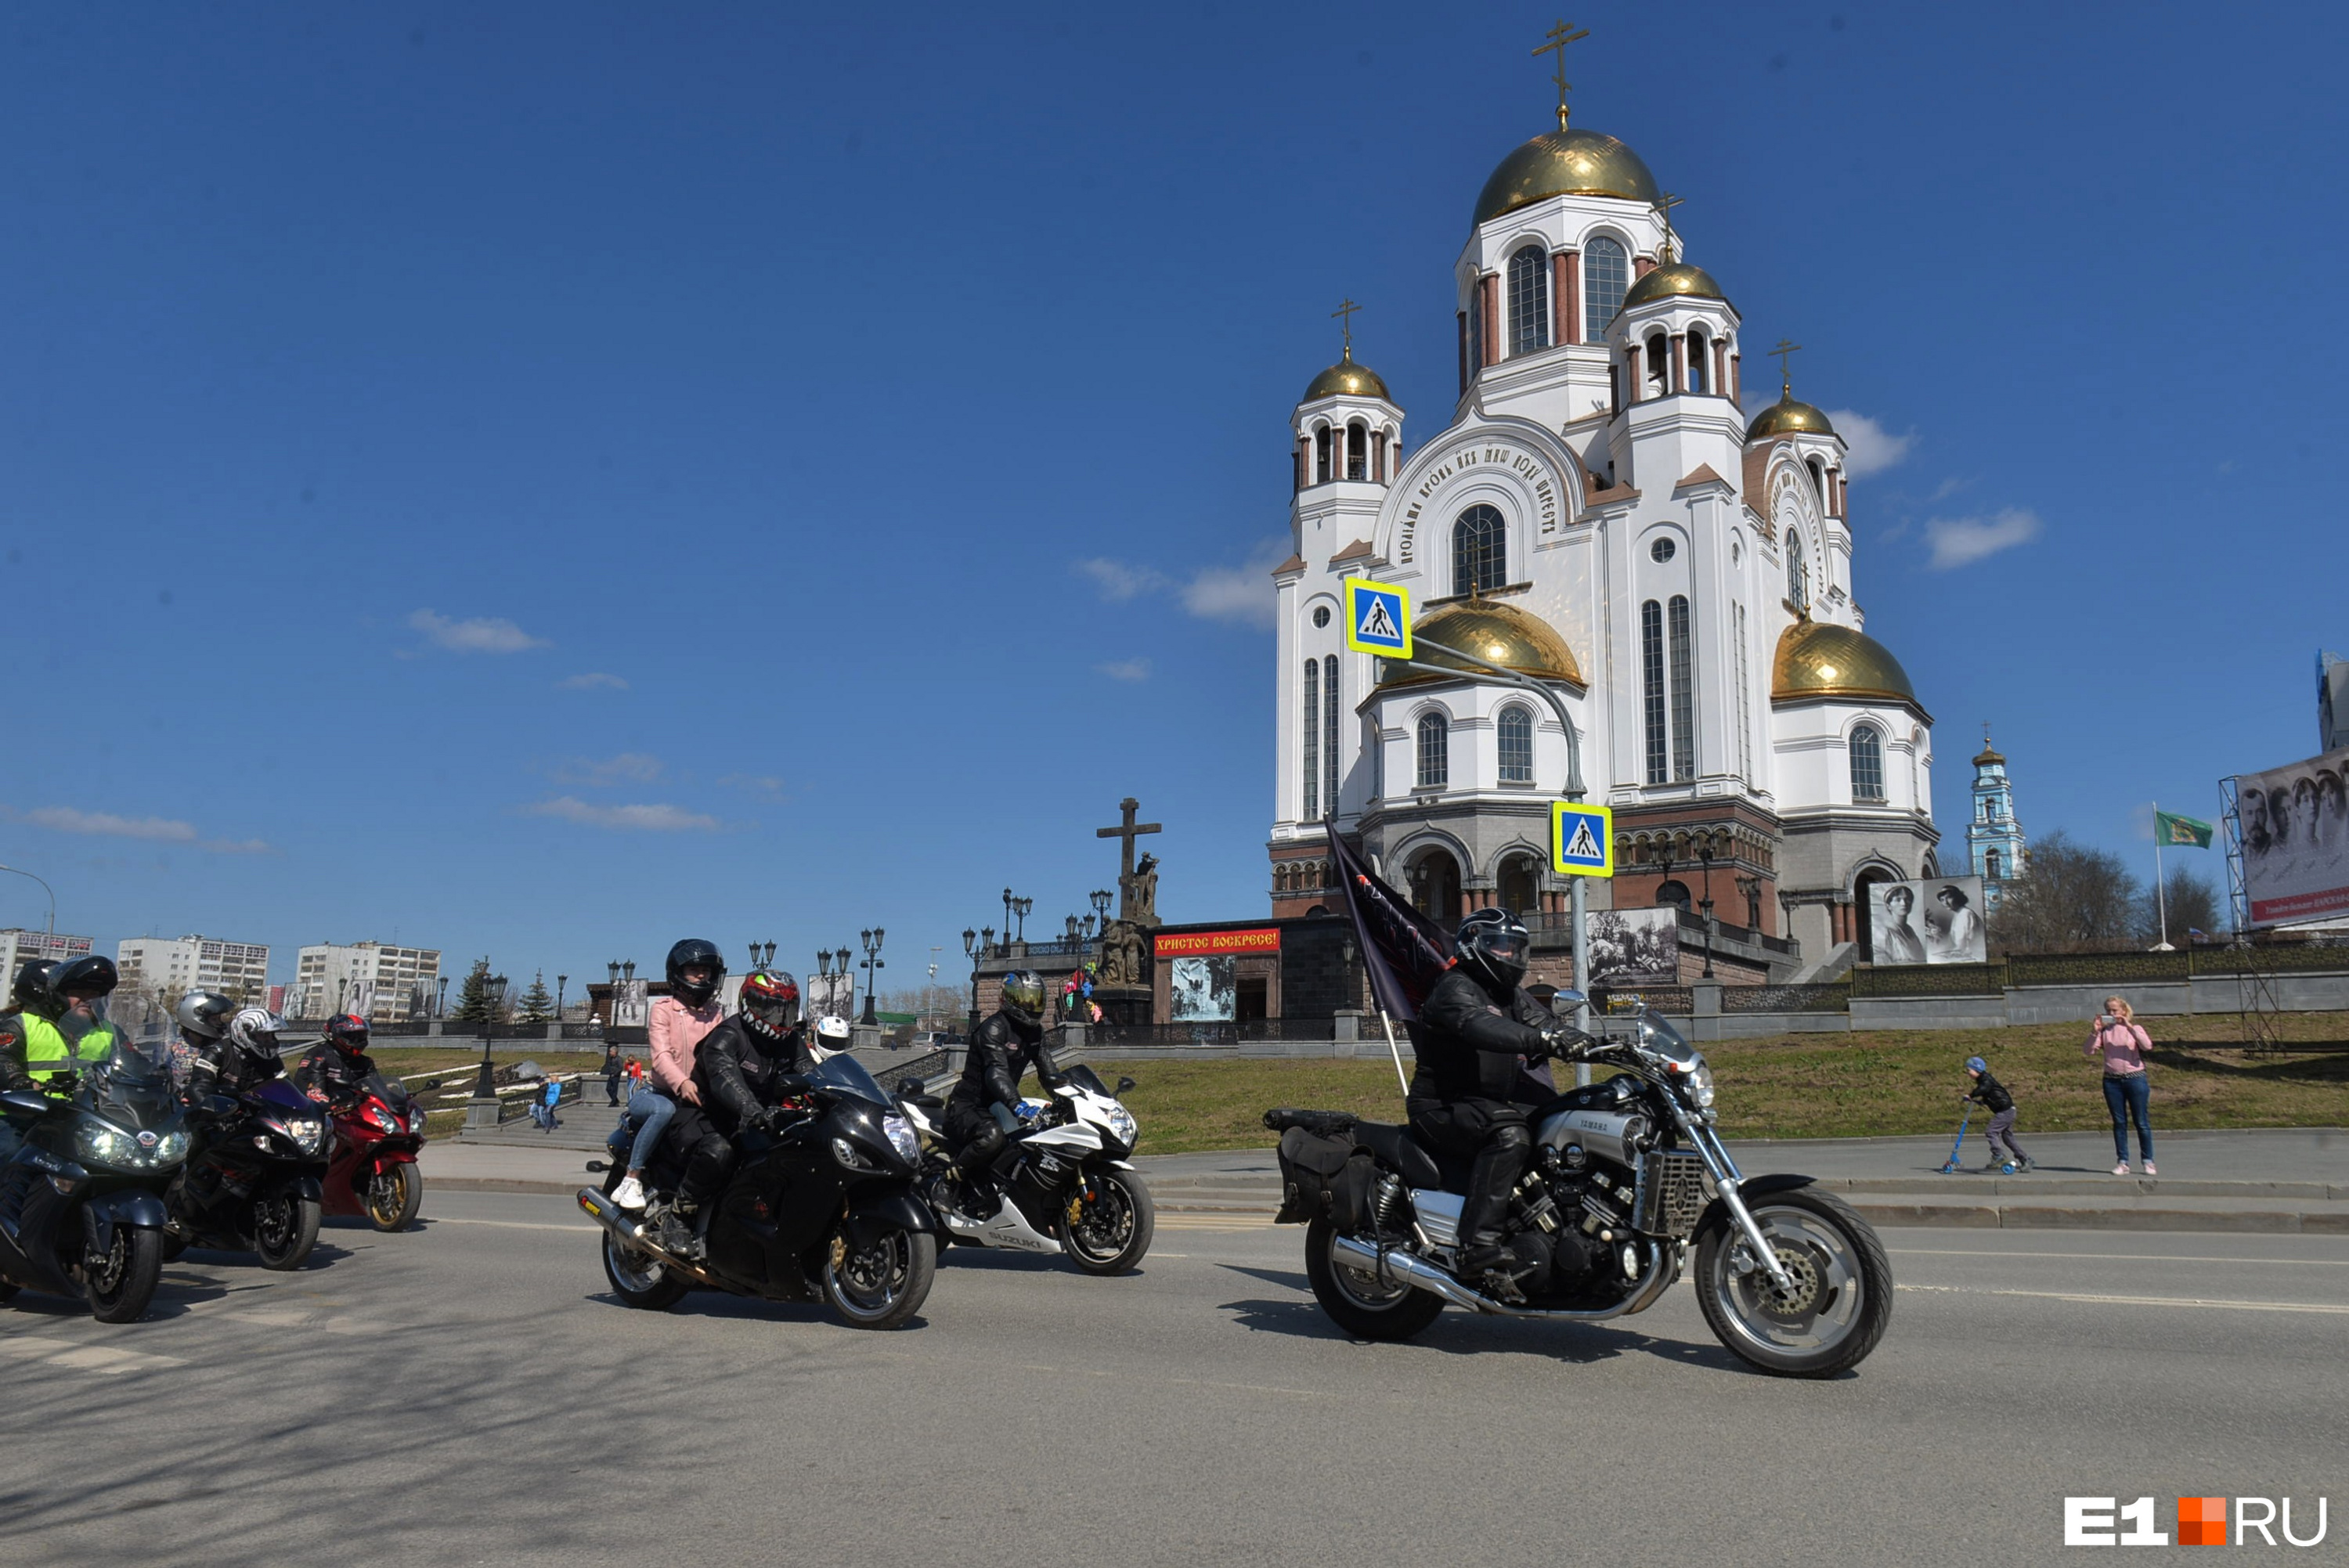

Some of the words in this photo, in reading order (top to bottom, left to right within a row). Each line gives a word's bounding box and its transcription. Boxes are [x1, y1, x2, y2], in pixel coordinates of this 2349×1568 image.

[1156, 937, 1208, 950] ХРИСТОС
[1213, 932, 1276, 947] ВОСКРЕСЕ!
[1580, 1120, 1607, 1130] YAMAHA
[988, 1231, 1041, 1248] SUZUKI
